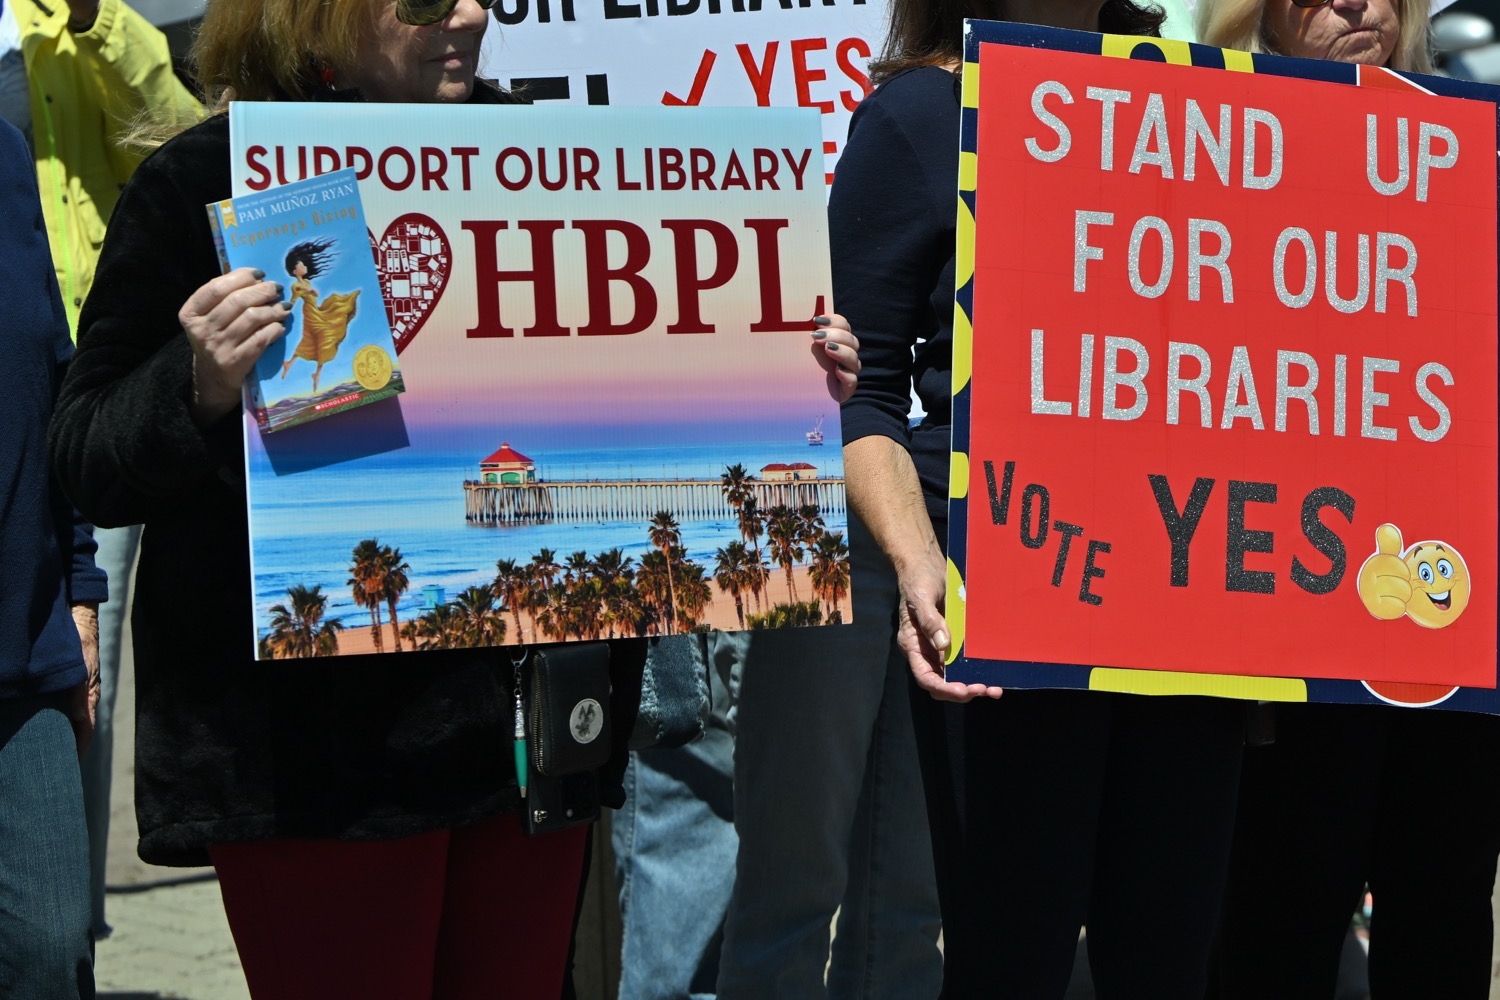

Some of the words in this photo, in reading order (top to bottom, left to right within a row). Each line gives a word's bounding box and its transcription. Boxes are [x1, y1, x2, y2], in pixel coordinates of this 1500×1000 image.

[735, 36, 875, 114] YES
[245, 145, 480, 191] SUPPORT
[495, 146, 600, 192] OUR
[616, 146, 813, 192] LIBRARY
[1024, 81, 1284, 191] STAND
[1366, 113, 1460, 203] UP
[239, 208, 267, 224] PAM
[270, 193, 319, 216] MUÑOZ
[322, 184, 354, 201] RYAN
[460, 217, 825, 340] HBPL
[1073, 209, 1235, 304] FOR
[1273, 225, 1418, 318] OUR
[320, 393, 360, 410] SCHOLASTIC
[1030, 328, 1456, 443] LIBRARIES
[983, 460, 1112, 607] VOTE
[1147, 473, 1356, 596] YES
